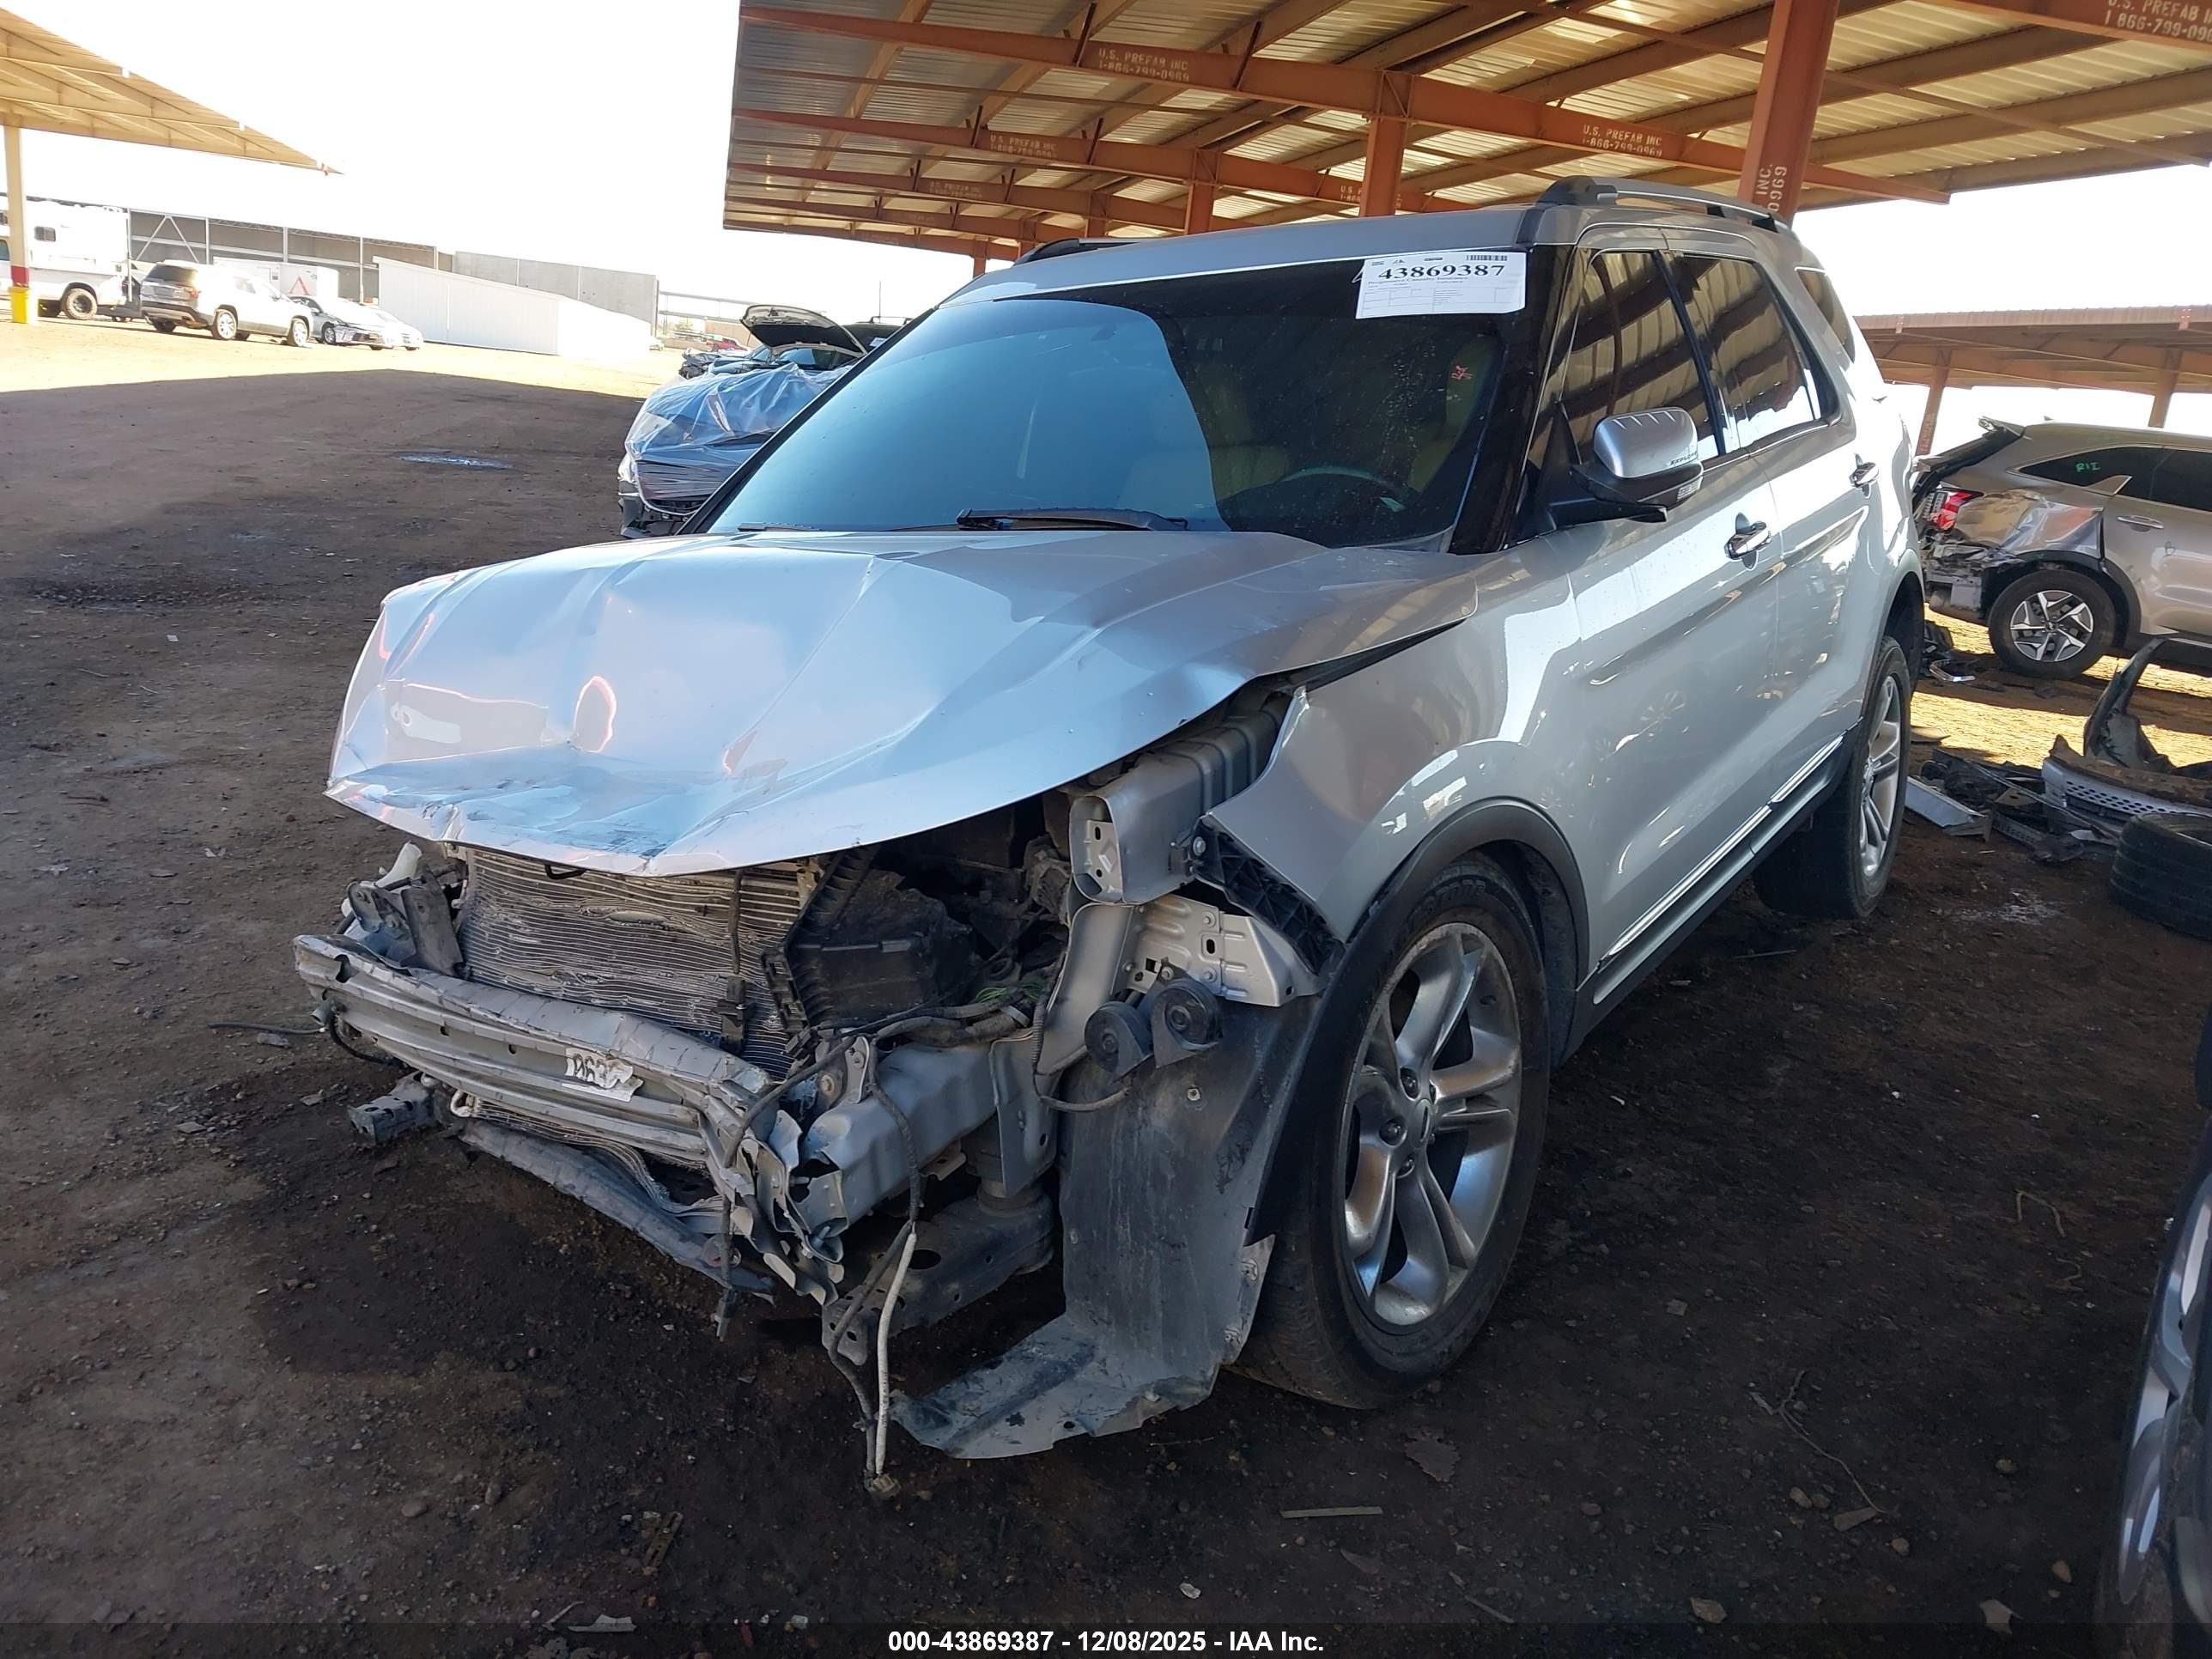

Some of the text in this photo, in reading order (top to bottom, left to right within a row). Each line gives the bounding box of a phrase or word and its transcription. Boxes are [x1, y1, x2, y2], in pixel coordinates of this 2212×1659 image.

[2142, 0, 2199, 21] PREFAB
[1099, 48, 1188, 70] U.S. PREFAB INC
[1583, 125, 1663, 146] U.S. PREFAB INC
[1378, 264, 1504, 279] 43869387
